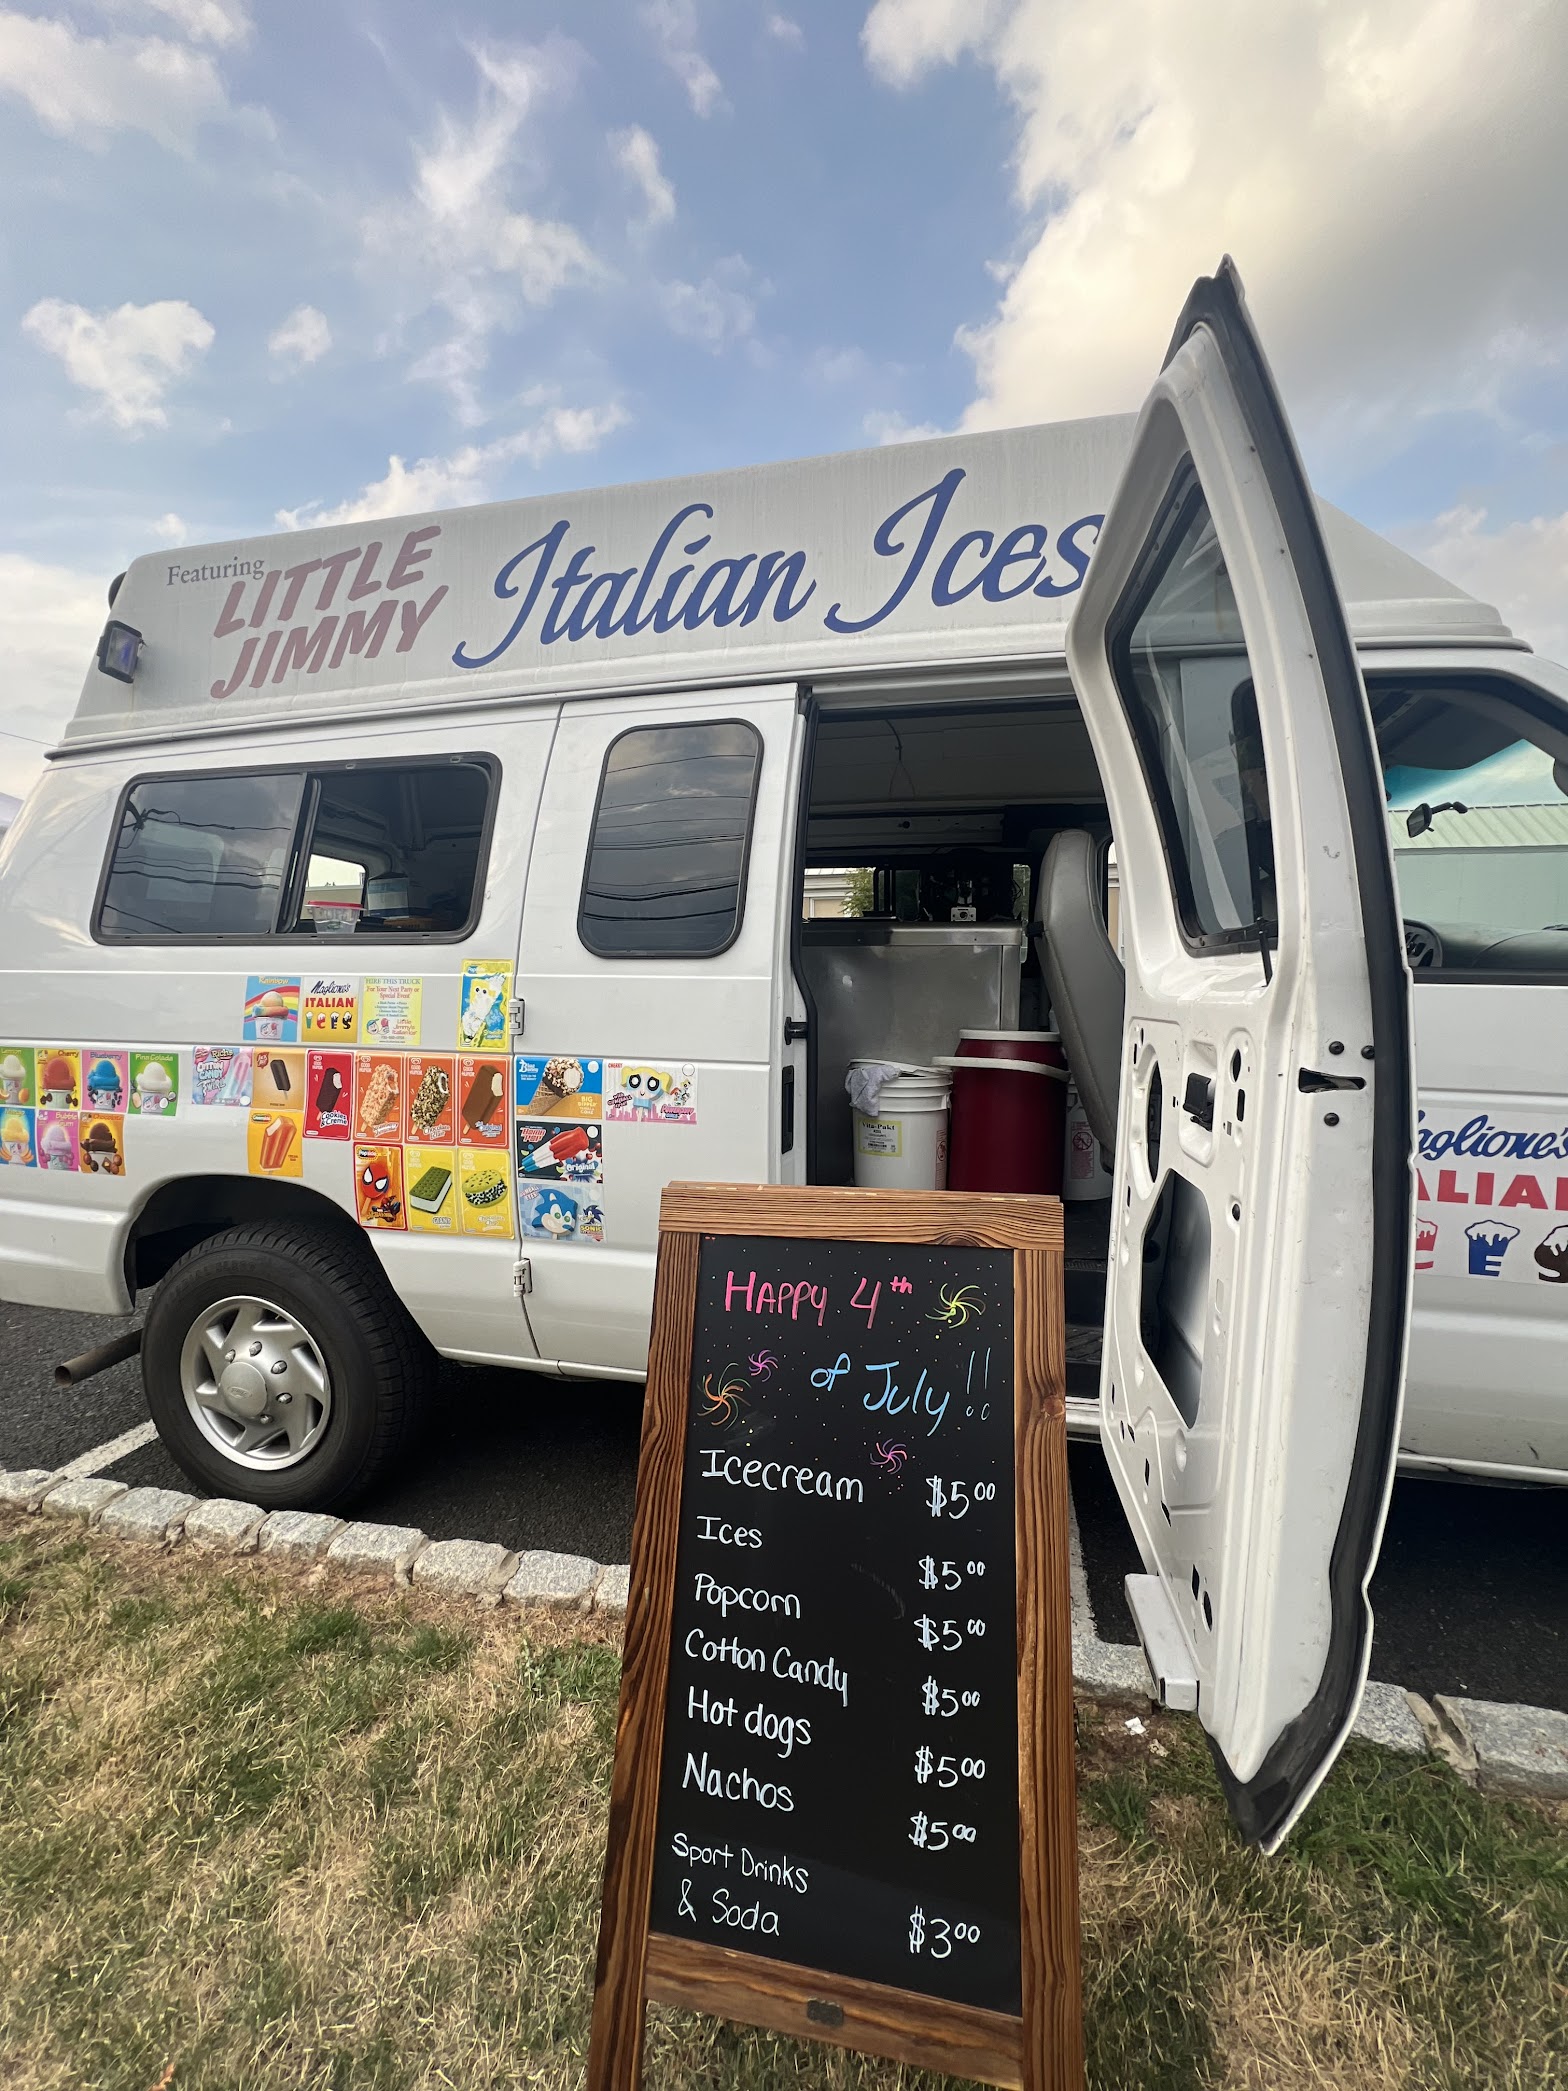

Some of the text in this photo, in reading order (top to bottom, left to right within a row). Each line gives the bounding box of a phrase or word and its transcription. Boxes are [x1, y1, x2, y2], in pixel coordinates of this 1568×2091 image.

[166, 556, 265, 586] Featuring
[213, 525, 442, 638] LITTLE
[451, 468, 1105, 669] Italian Ices
[210, 584, 449, 699] JIMMY
[305, 997, 355, 1008] ITALIAN
[57, 1050, 79, 1058] Cherry
[90, 1051, 122, 1060] Blueberry
[55, 1112, 78, 1121] Bubble
[321, 1111, 346, 1121] Cookies
[566, 1162, 596, 1172] Original
[810, 1353, 851, 1391] of
[700, 1449, 864, 1503] Icecream
[697, 1516, 763, 1549] Ices
[695, 1573, 801, 1618] Popcorn
[685, 1629, 765, 1672] Cotton
[772, 1647, 848, 1707] Candy
[687, 1686, 738, 1727] Hot
[744, 1704, 812, 1758] dogs
[682, 1752, 794, 1812] Nachos
[671, 1832, 809, 1894] Sport Drinks
[678, 1879, 697, 1922] &
[712, 1888, 780, 1936] Soda
